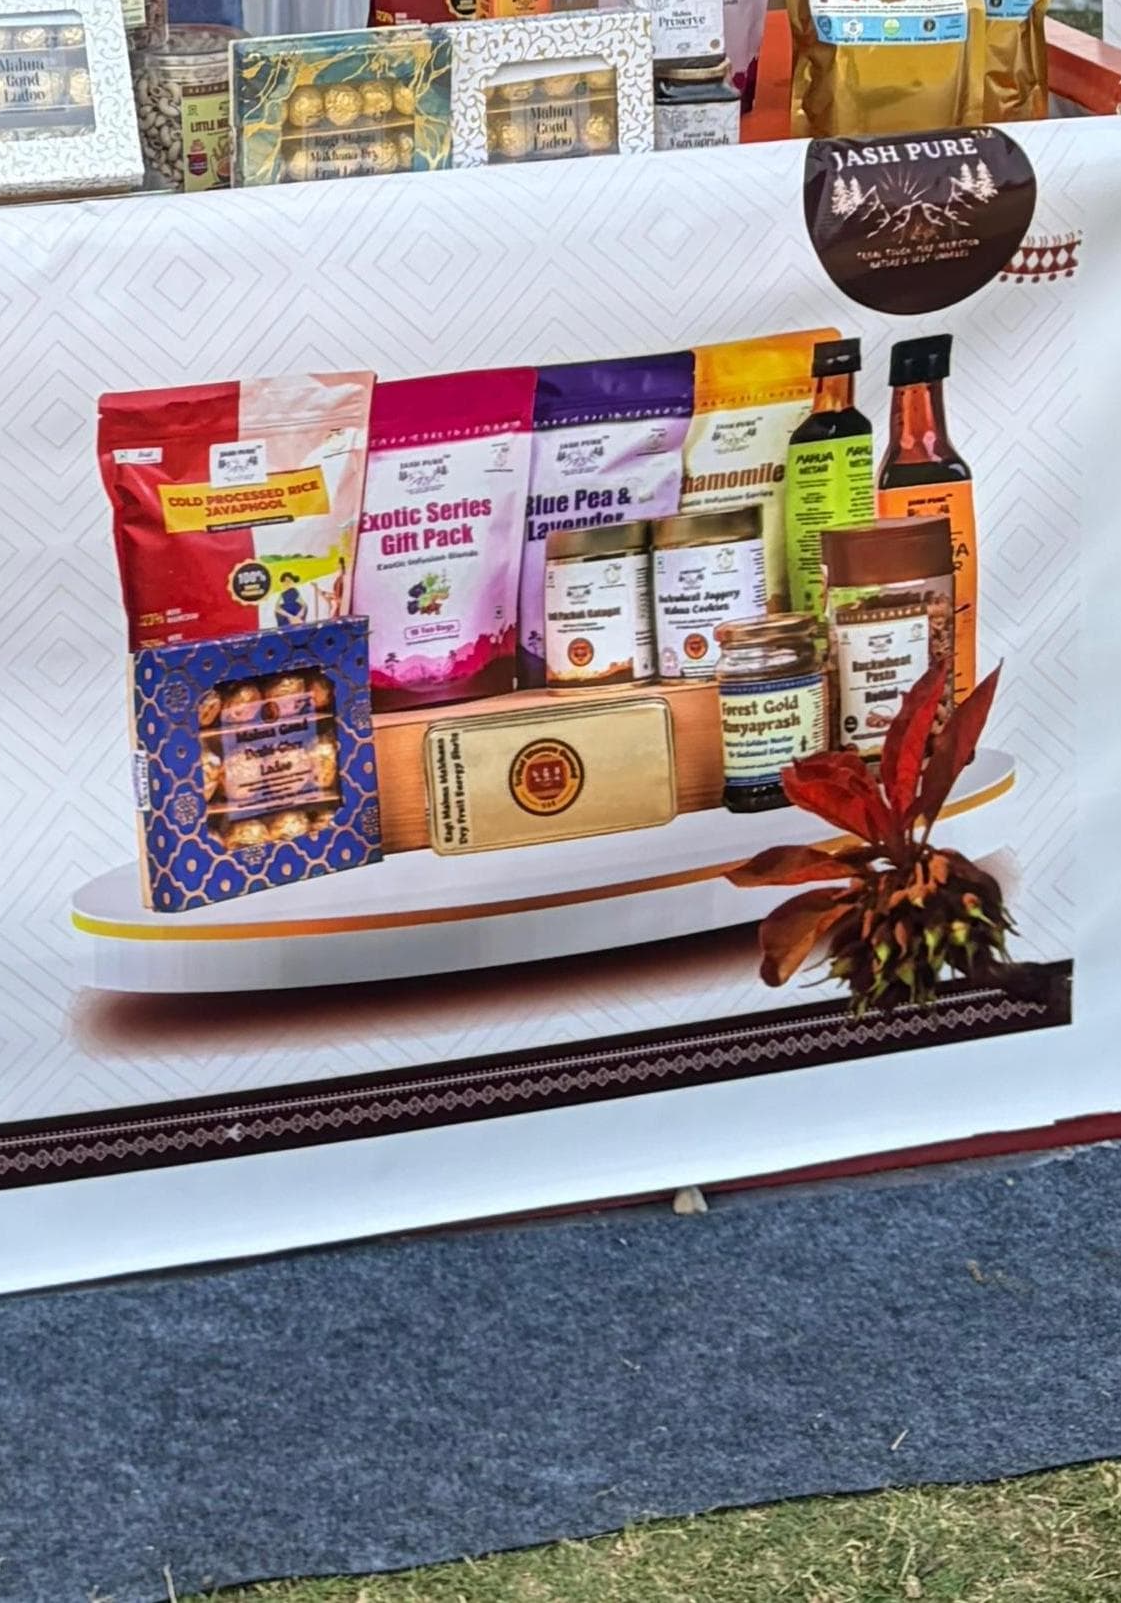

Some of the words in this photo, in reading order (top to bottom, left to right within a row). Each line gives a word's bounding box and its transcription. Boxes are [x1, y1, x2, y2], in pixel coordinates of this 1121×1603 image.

[658, 15, 706, 28] Preserve
[0, 57, 45, 72] Mahua
[530, 104, 572, 119] Mahua
[190, 119, 215, 133] LITTLE
[831, 144, 901, 170] JASH
[905, 137, 978, 161] PURE
[796, 451, 835, 465] MAHUA
[682, 462, 785, 495] hamomile
[168, 496, 203, 507] COLD
[206, 487, 285, 505] PROCESSED
[288, 480, 320, 496] RICE
[526, 493, 570, 517] Blue
[574, 489, 614, 511] Pea
[617, 487, 633, 505] &
[359, 506, 422, 535] Exotic
[426, 497, 492, 524] Series
[381, 531, 420, 556] Gift
[423, 523, 474, 550] Pack
[852, 653, 912, 673] Buckwheat
[865, 669, 897, 684] Pasta
[763, 694, 799, 714] Gold
[453, 762, 464, 798] Energy
[458, 826, 470, 845] Dry
